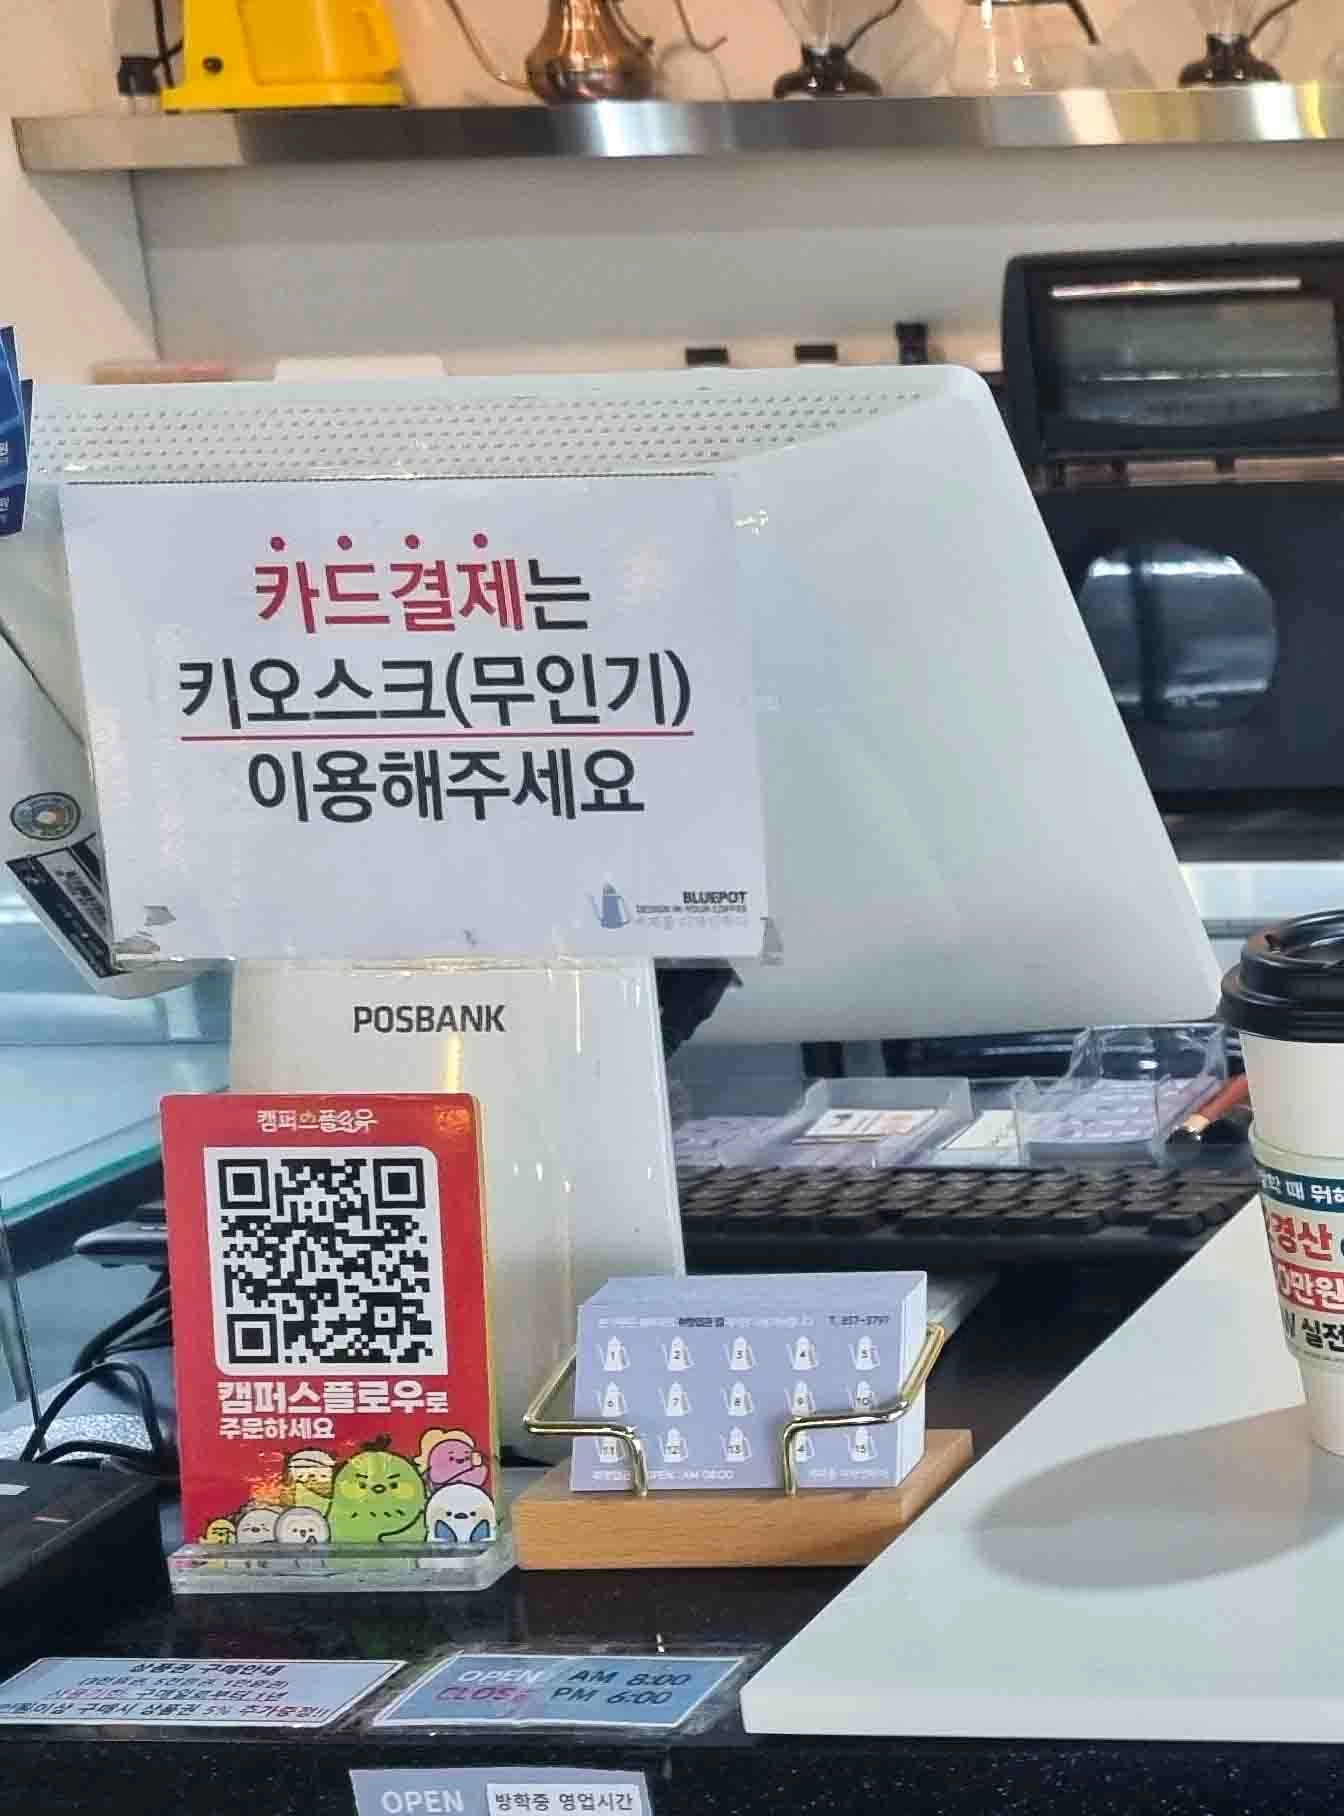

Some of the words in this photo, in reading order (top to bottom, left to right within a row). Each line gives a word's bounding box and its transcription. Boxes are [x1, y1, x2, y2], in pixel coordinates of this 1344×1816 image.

[255, 559, 590, 633] 카드결제는
[180, 650, 691, 729] 키오스크(무인기)
[247, 748, 645, 823] 이용해주세요
[353, 1005, 506, 1034] POSBANK
[1285, 1180, 1304, 1200] 때
[216, 1380, 449, 1415] 캠퍼스플로우로
[219, 1417, 336, 1440] 주문하세요
[457, 1669, 545, 1683] OPEN
[568, 1670, 617, 1685] AM
[625, 1672, 692, 1687] 8:00
[552, 1687, 598, 1702] PM
[607, 1691, 674, 1705] 6:00
[380, 1789, 465, 1815] OPEN
[559, 1792, 633, 1812] 영업시간
